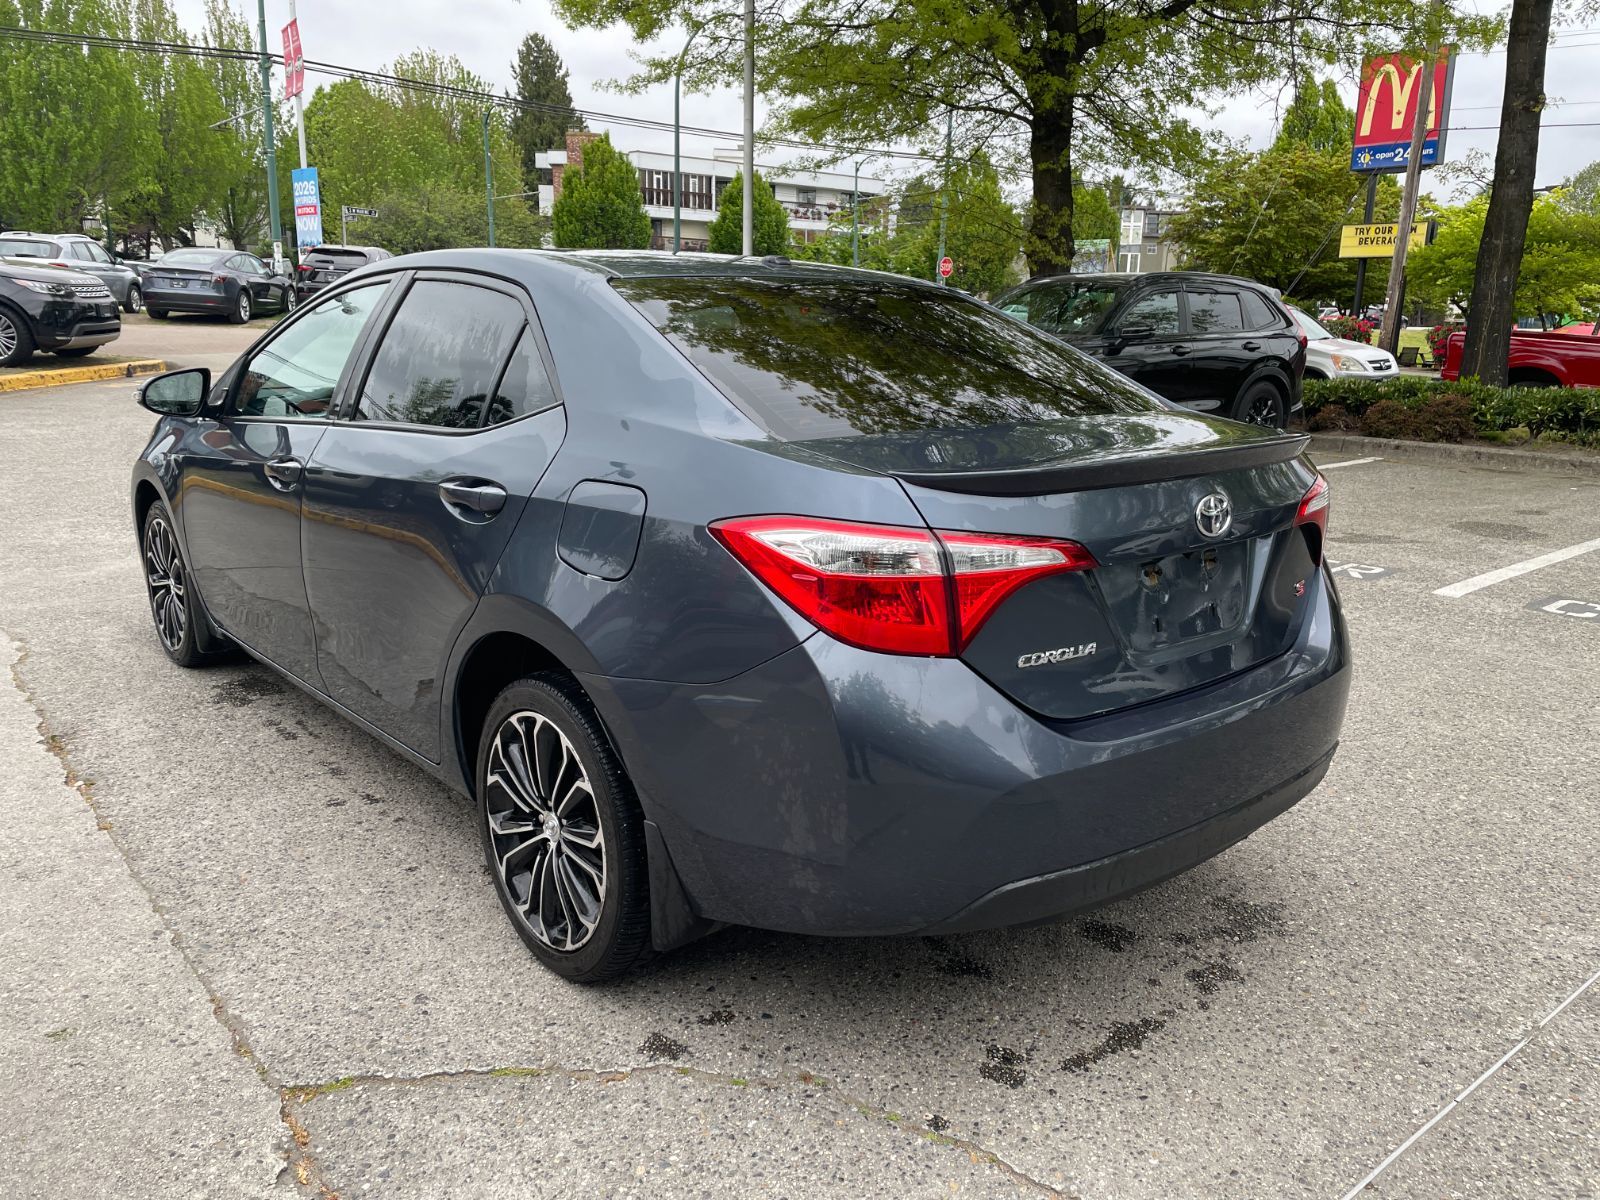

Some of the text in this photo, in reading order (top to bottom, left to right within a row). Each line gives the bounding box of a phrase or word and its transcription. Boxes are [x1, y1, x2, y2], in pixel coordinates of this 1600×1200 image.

[1375, 151, 1394, 159] open
[294, 180, 315, 196] 2026
[297, 217, 318, 231] NOW
[1355, 226, 1393, 236] TRY OUR
[940, 262, 953, 271] STOP
[1017, 641, 1097, 668] COROLLA
